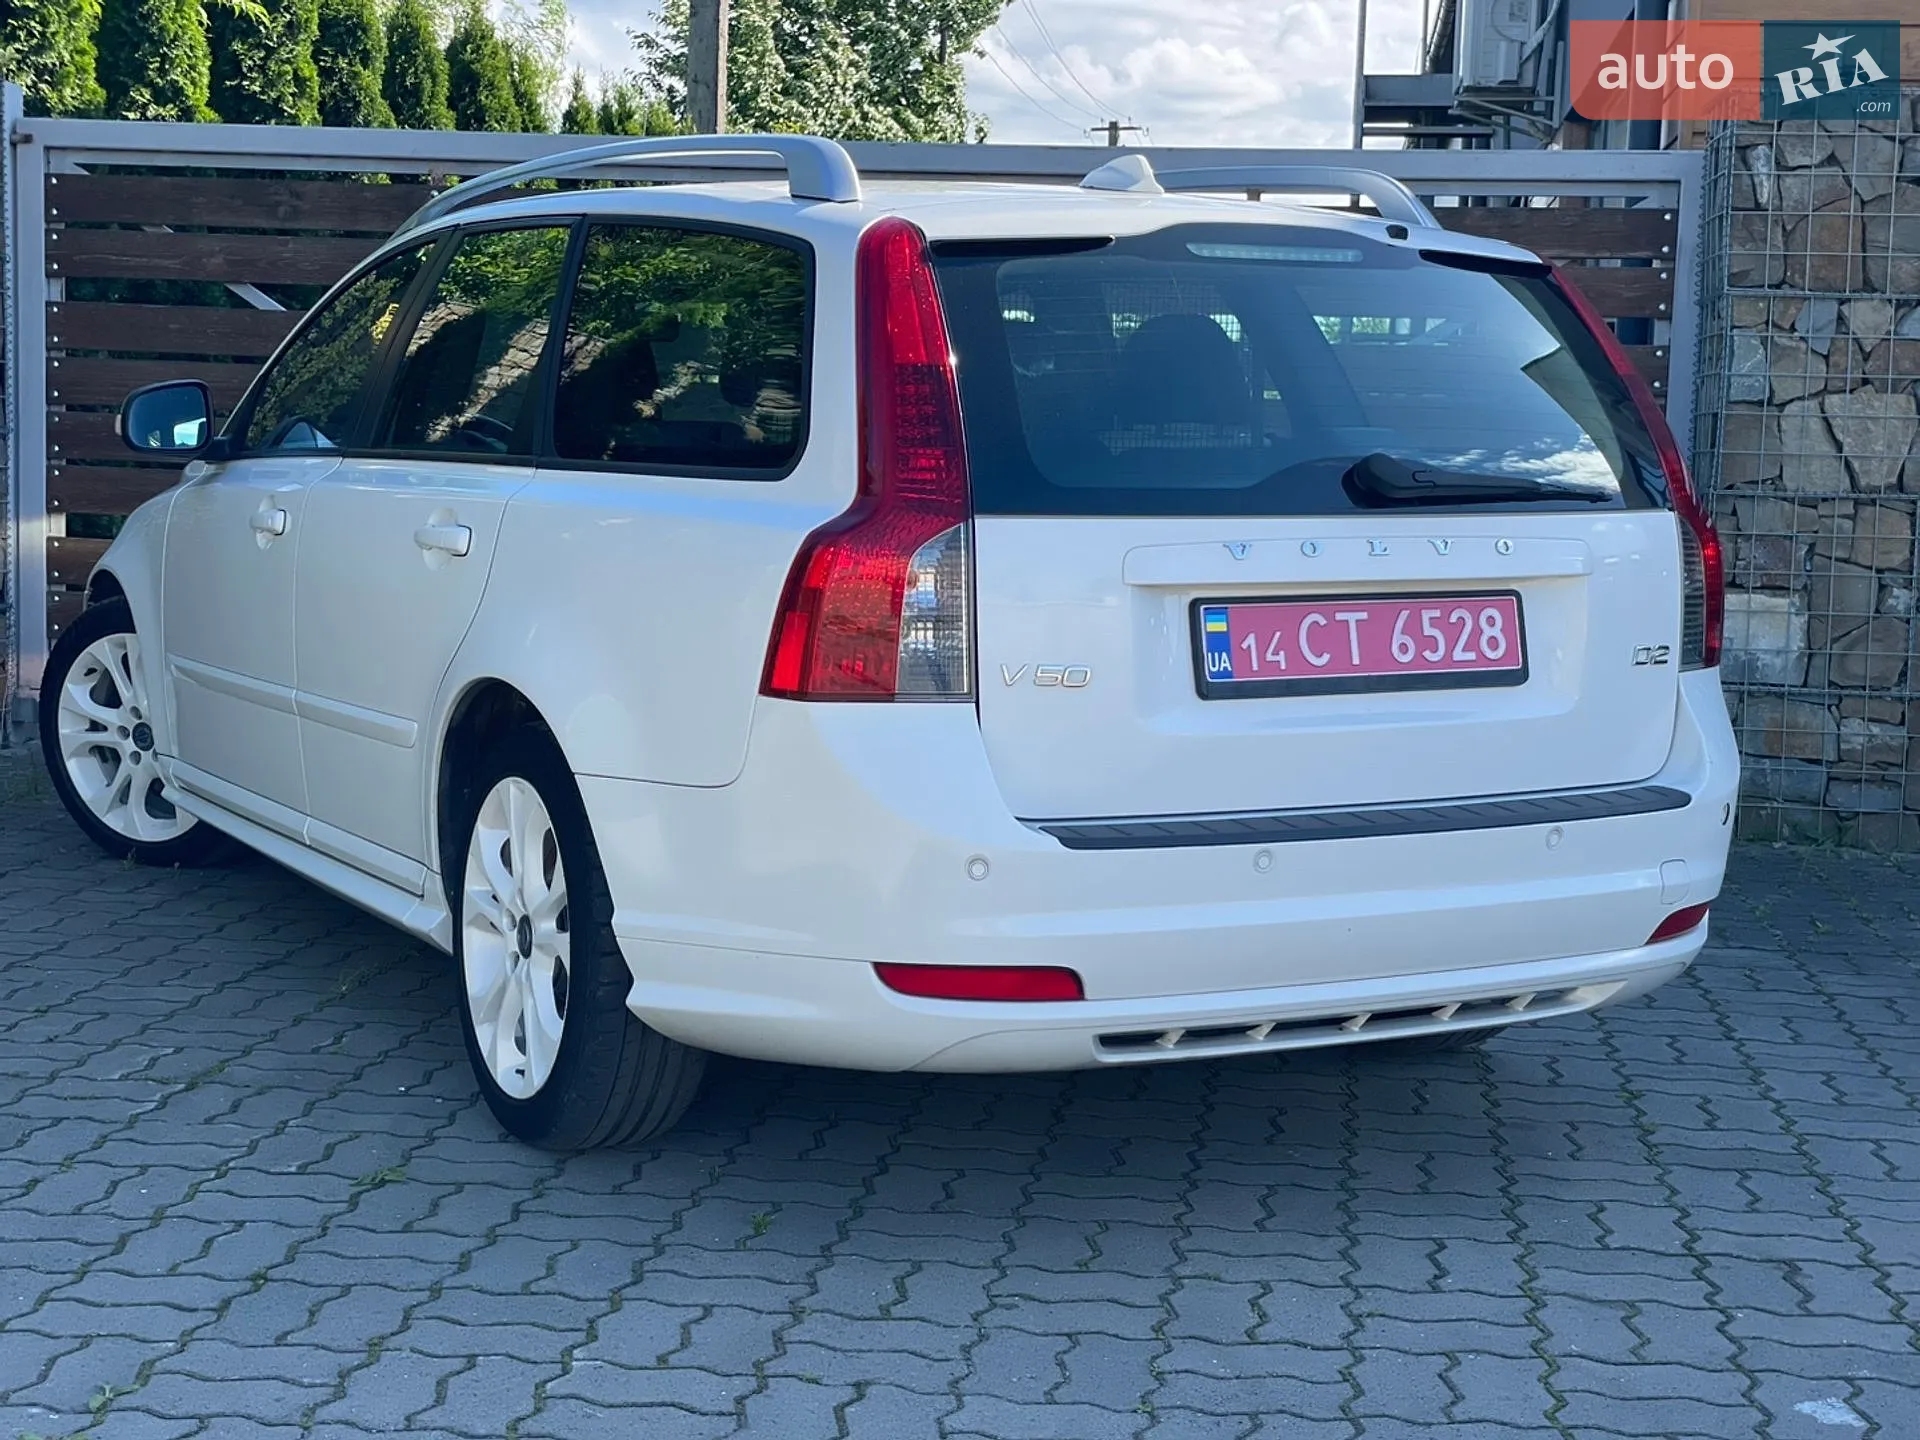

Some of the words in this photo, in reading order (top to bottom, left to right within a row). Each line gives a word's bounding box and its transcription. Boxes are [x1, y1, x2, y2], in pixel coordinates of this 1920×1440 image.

[1222, 538, 1515, 561] VOLVO
[1206, 651, 1232, 672] UA
[1240, 630, 1287, 671] 14
[1297, 611, 1369, 667] CT
[1391, 607, 1507, 664] 6528
[1631, 645, 1670, 666] D2
[1000, 663, 1091, 688] V50
